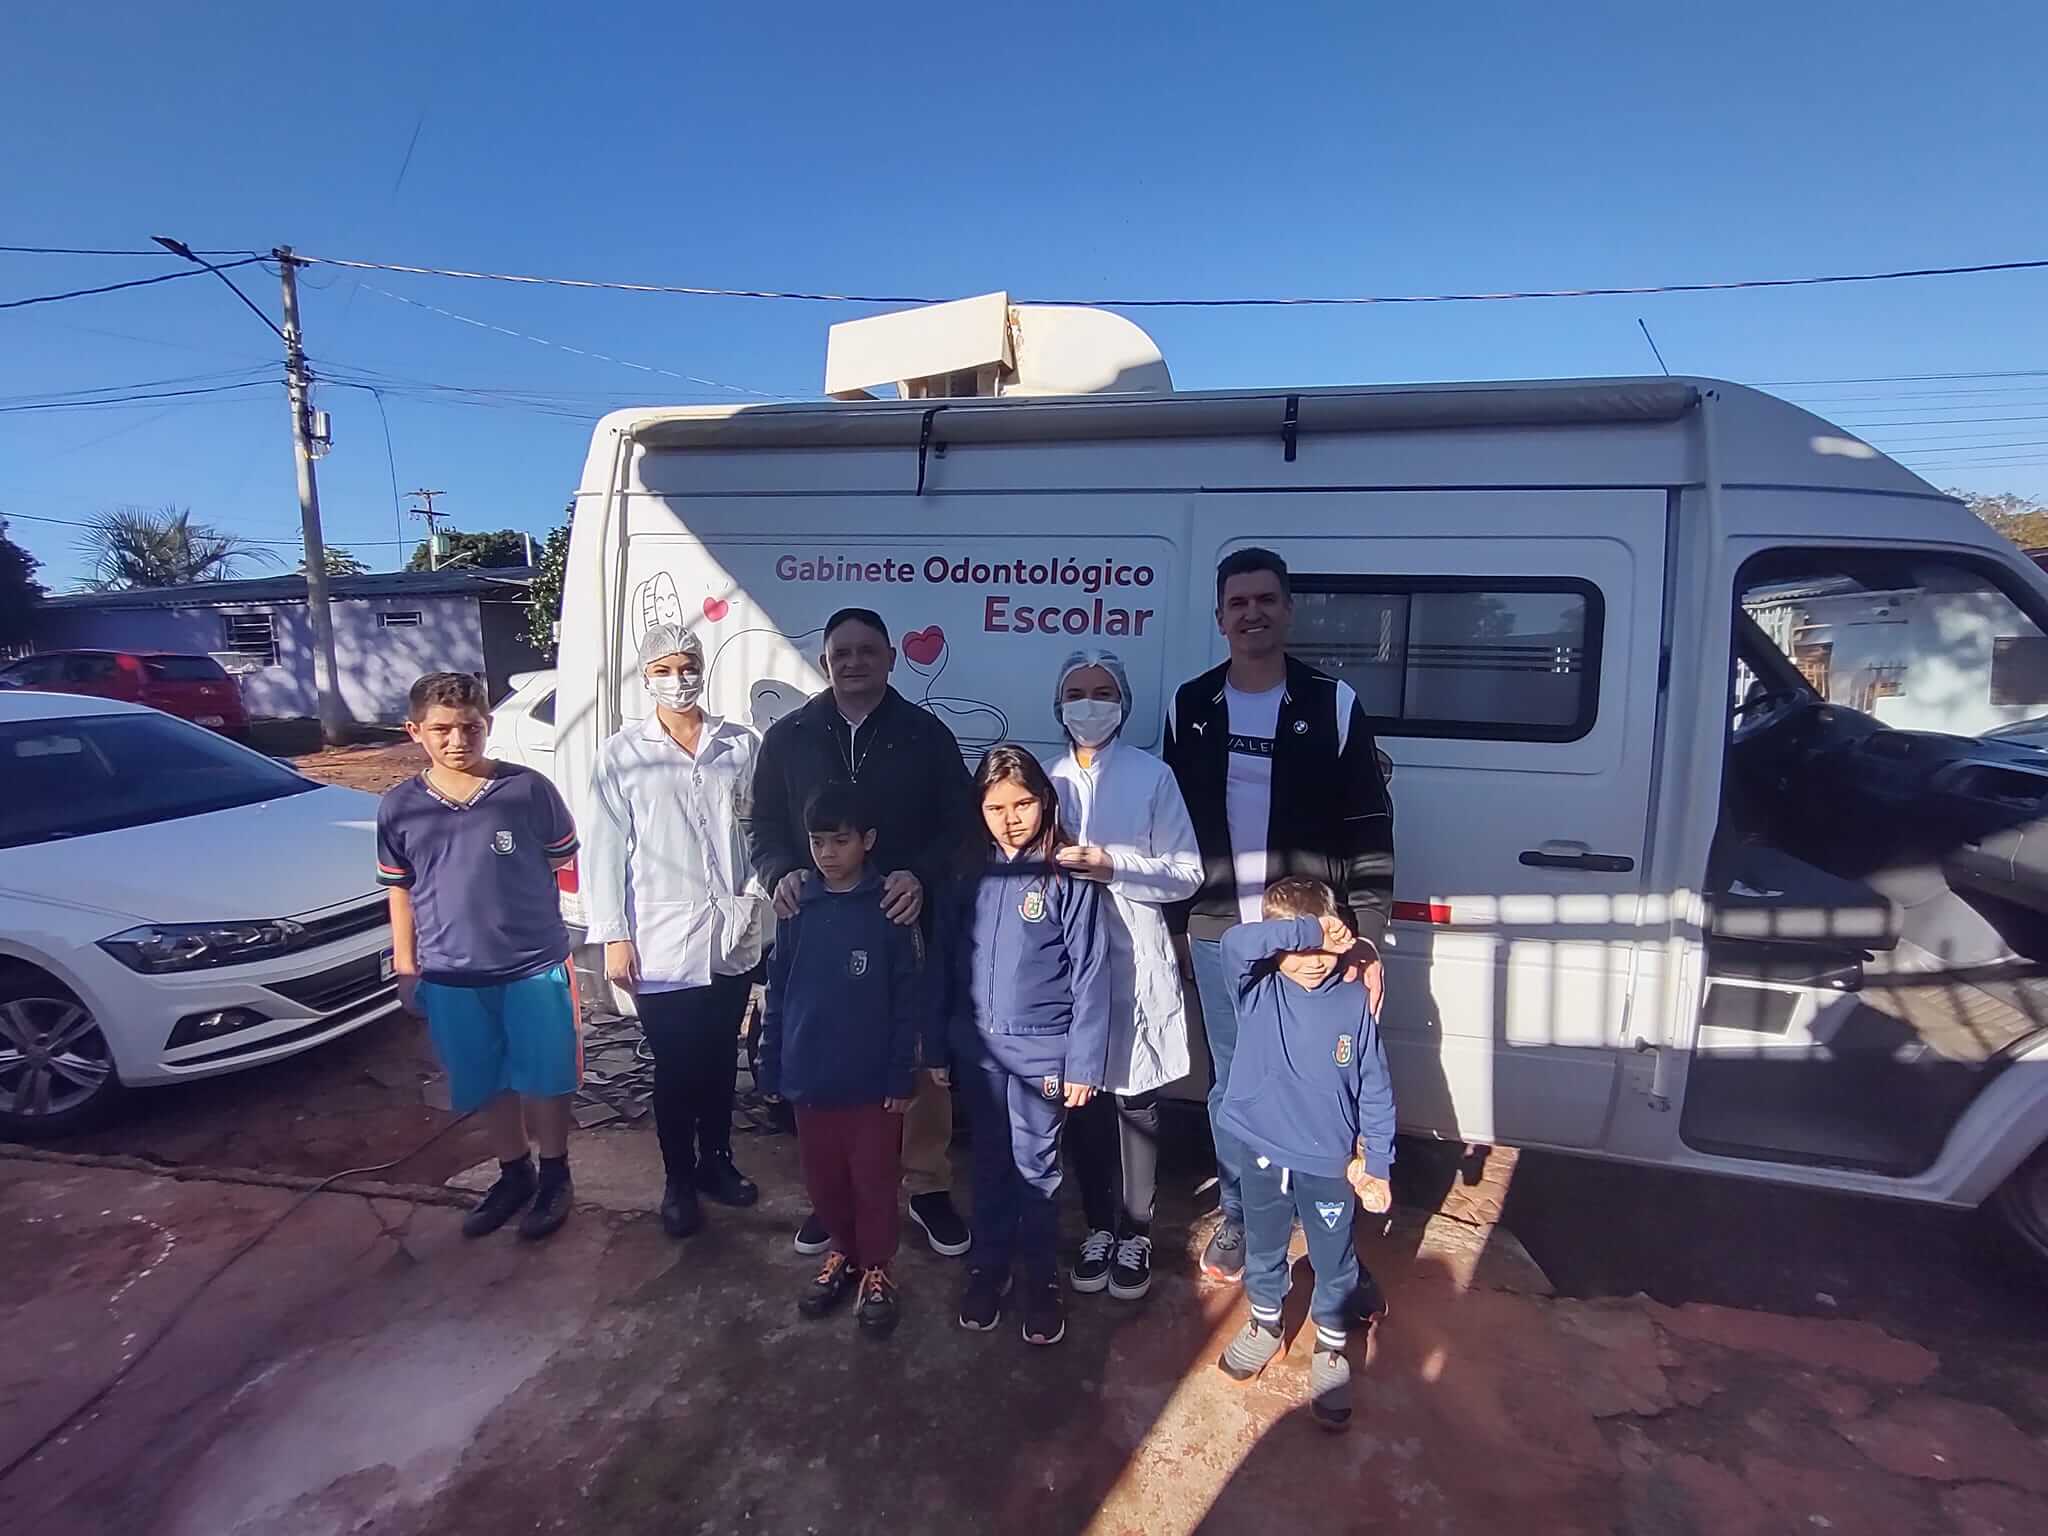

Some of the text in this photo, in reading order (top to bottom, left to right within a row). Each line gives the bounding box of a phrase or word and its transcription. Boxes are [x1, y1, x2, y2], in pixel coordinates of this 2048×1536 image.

[775, 554, 1155, 594] Gabinete Odontológico
[984, 595, 1155, 637] Escolar
